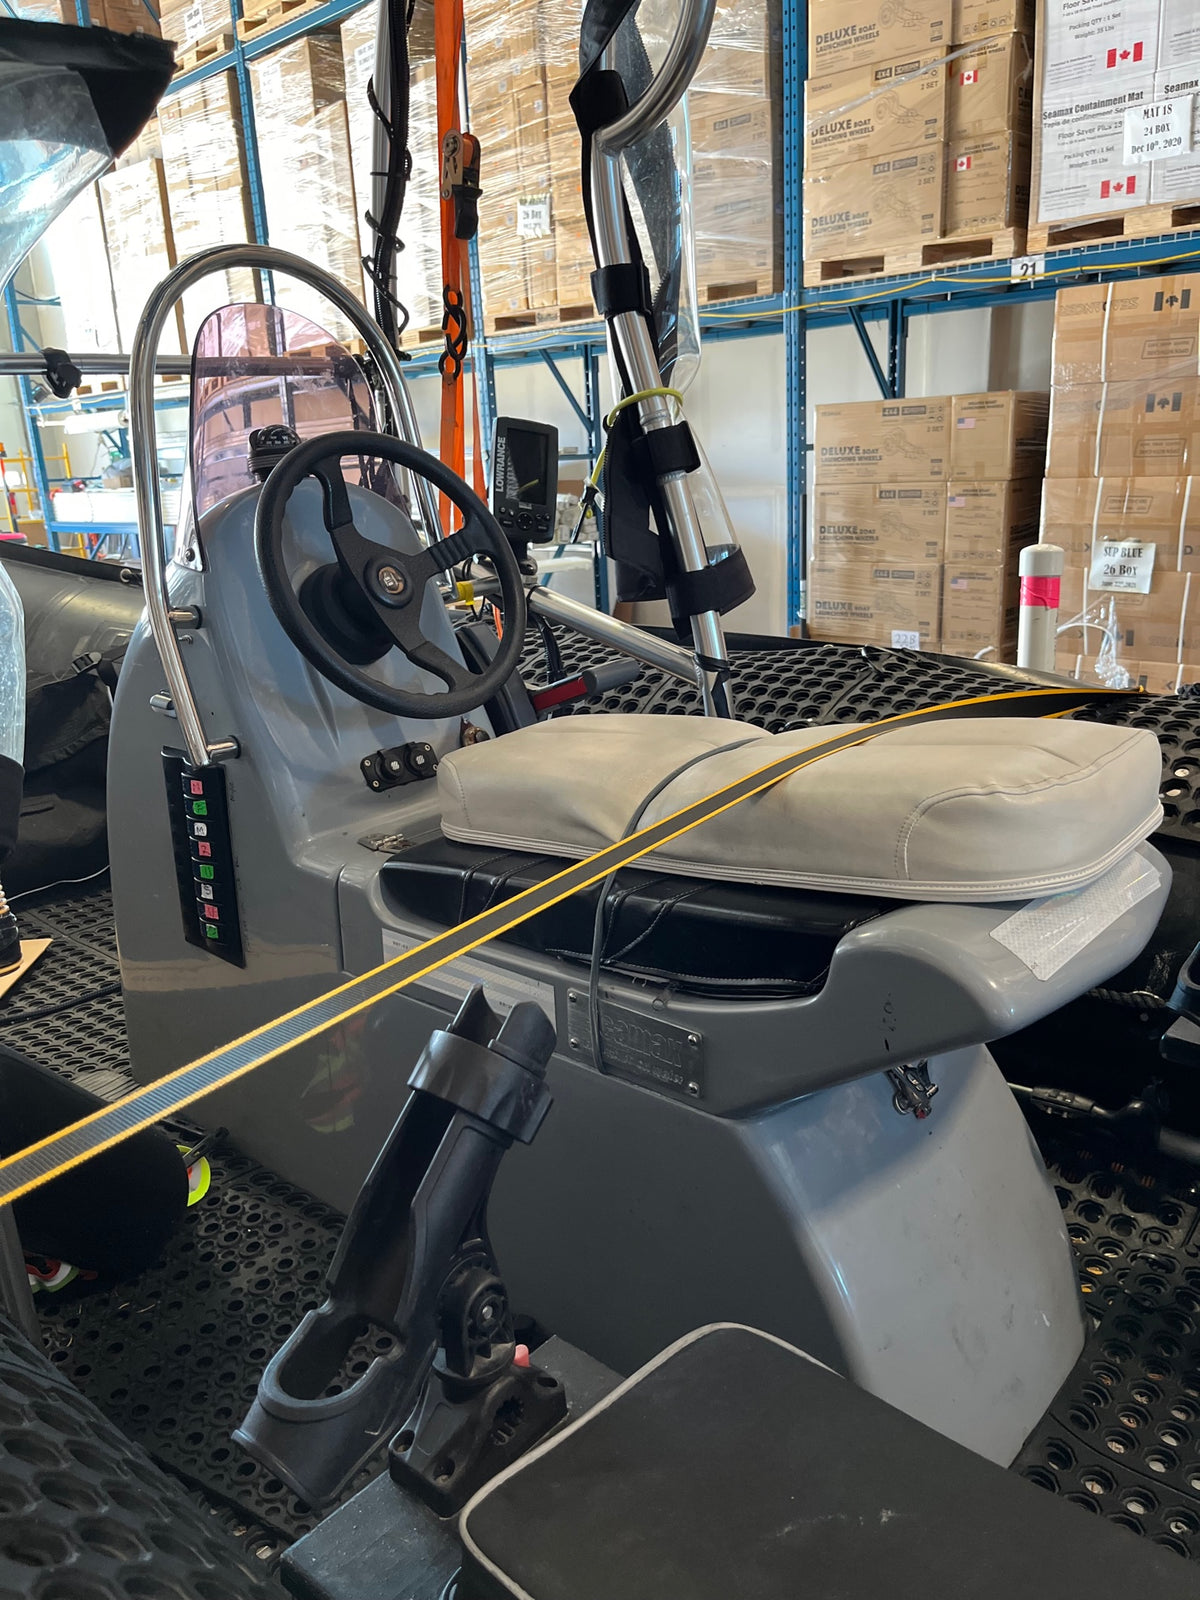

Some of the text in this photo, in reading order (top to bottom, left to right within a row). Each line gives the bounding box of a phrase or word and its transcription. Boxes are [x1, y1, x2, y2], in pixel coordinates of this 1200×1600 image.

[1068, 21, 1091, 31] Packing
[1090, 17, 1103, 26] QTY
[815, 23, 877, 46] DELUXE BOAT
[815, 30, 880, 53] LAUNCHING WHEELS
[926, 81, 939, 89] SET
[1164, 79, 1199, 94] Seamax
[1042, 91, 1144, 120] Seamax Containment Mat
[1071, 109, 1113, 123] confinement
[1142, 106, 1161, 120] MAT
[853, 118, 871, 128] BOAT
[1143, 122, 1170, 136] 24 BOX
[811, 125, 875, 145] LAUNCHING WHEELS
[1057, 132, 1075, 140] Floor
[1075, 127, 1096, 136] Saver
[1131, 144, 1145, 155] Dec
[1162, 136, 1182, 149] 2020
[923, 176, 936, 185] SET
[811, 211, 850, 228] DELUXE
[811, 223, 846, 236] LAUNCHING
[1020, 262, 1036, 281] 21
[820, 446, 861, 456] DELUXE
[495, 435, 506, 492] LOWRANCE
[819, 525, 858, 535] DELUXE
[1103, 546, 1144, 558] SEP BLUE
[1103, 563, 1116, 575] 26
[815, 601, 853, 611] DELUXE
[203, 885, 212, 896] S
